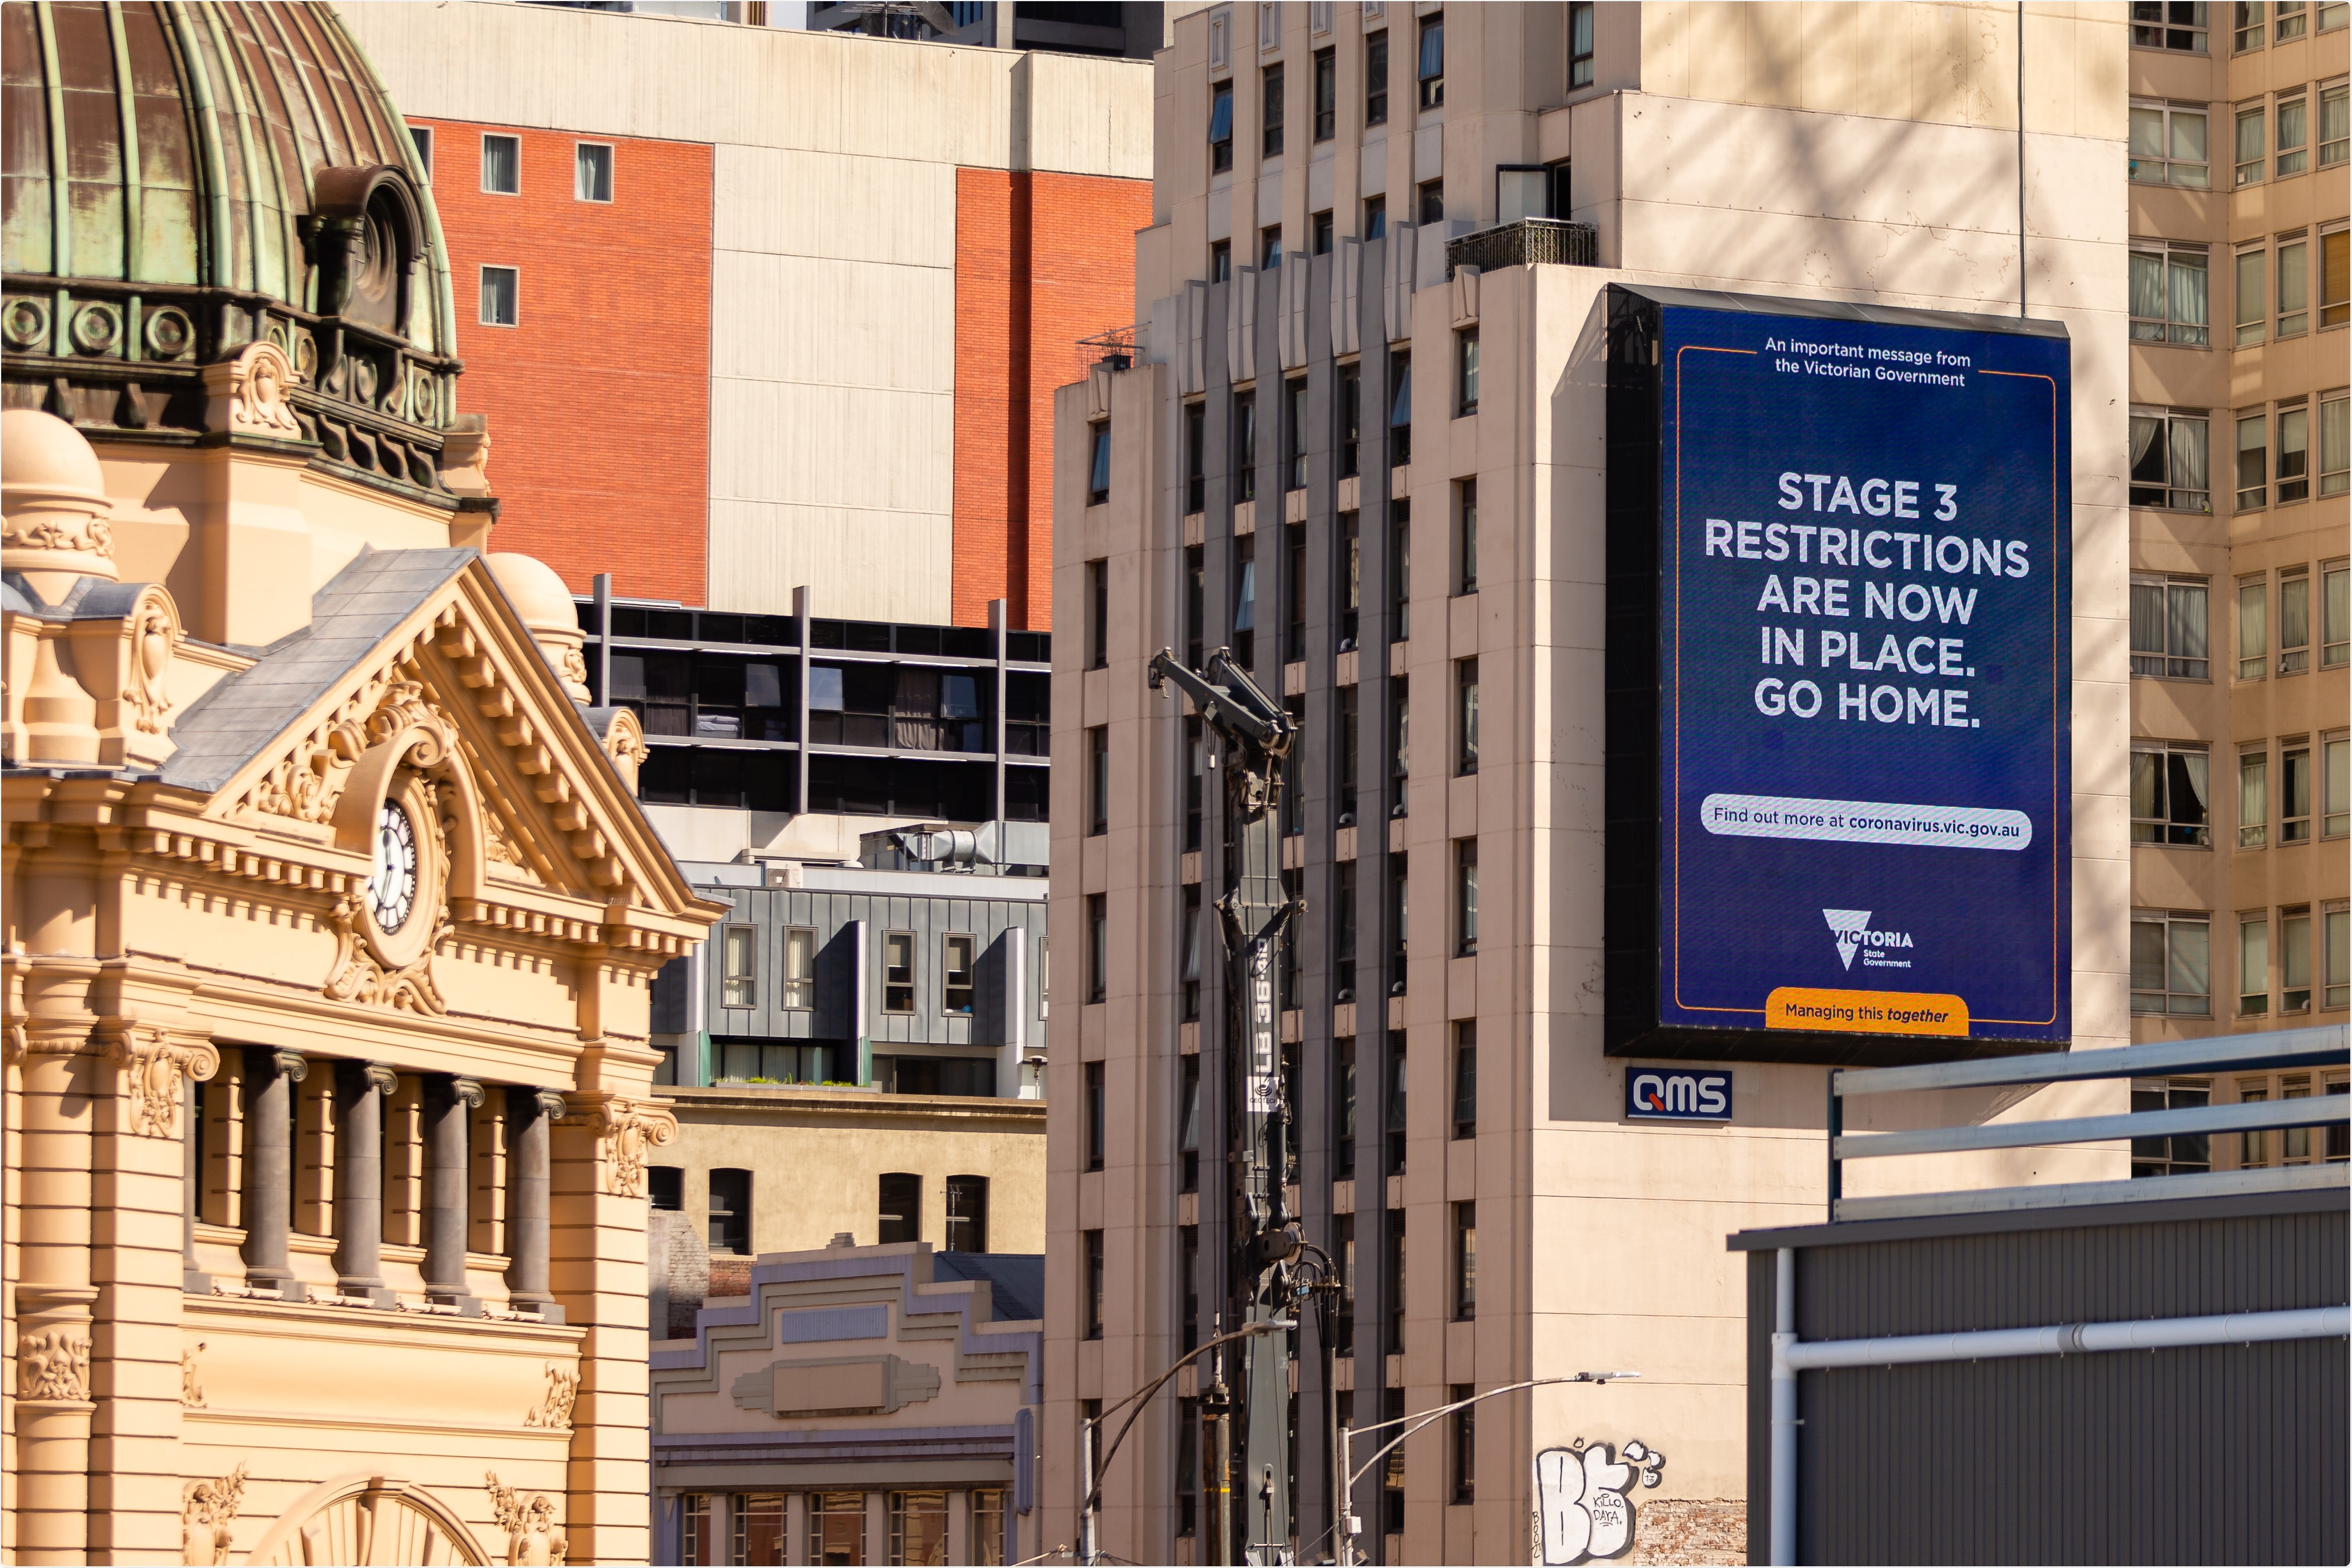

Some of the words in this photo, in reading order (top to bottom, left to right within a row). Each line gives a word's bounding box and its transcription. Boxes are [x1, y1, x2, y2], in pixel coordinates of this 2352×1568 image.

[1765, 337, 1786, 352] An
[1790, 339, 1864, 359] important
[1868, 349, 1932, 365] message
[1936, 351, 1971, 367] from
[1775, 358, 1799, 373] the
[1804, 360, 1870, 379] Victorian
[1875, 366, 1965, 387] Government
[1778, 472, 1919, 519] STAGE
[1933, 483, 1957, 521] 3
[1705, 518, 2029, 578] RESTRICTIONS
[1756, 574, 1850, 617] ARE
[1865, 581, 1978, 625] NOW
[1762, 626, 1804, 666] IN
[1821, 630, 1975, 677] PLACE.
[1754, 677, 1822, 718] GO
[1839, 683, 1980, 728] HOME.
[1714, 807, 1748, 823] Find
[1754, 811, 1779, 824] out
[1784, 814, 1824, 827] more
[1829, 814, 1844, 828] at
[1849, 817, 2020, 838] coronavirus.vic.gov.au
[1834, 930, 1914, 948] VICTORIA
[1863, 949, 1885, 958] State
[1863, 958, 1912, 968] Government
[1786, 1003, 1854, 1022] Managing
[1858, 1006, 1883, 1020] this
[1887, 1008, 1949, 1024] together
[1255, 1032, 1272, 1073] LB
[1633, 1075, 1726, 1113] QMS
